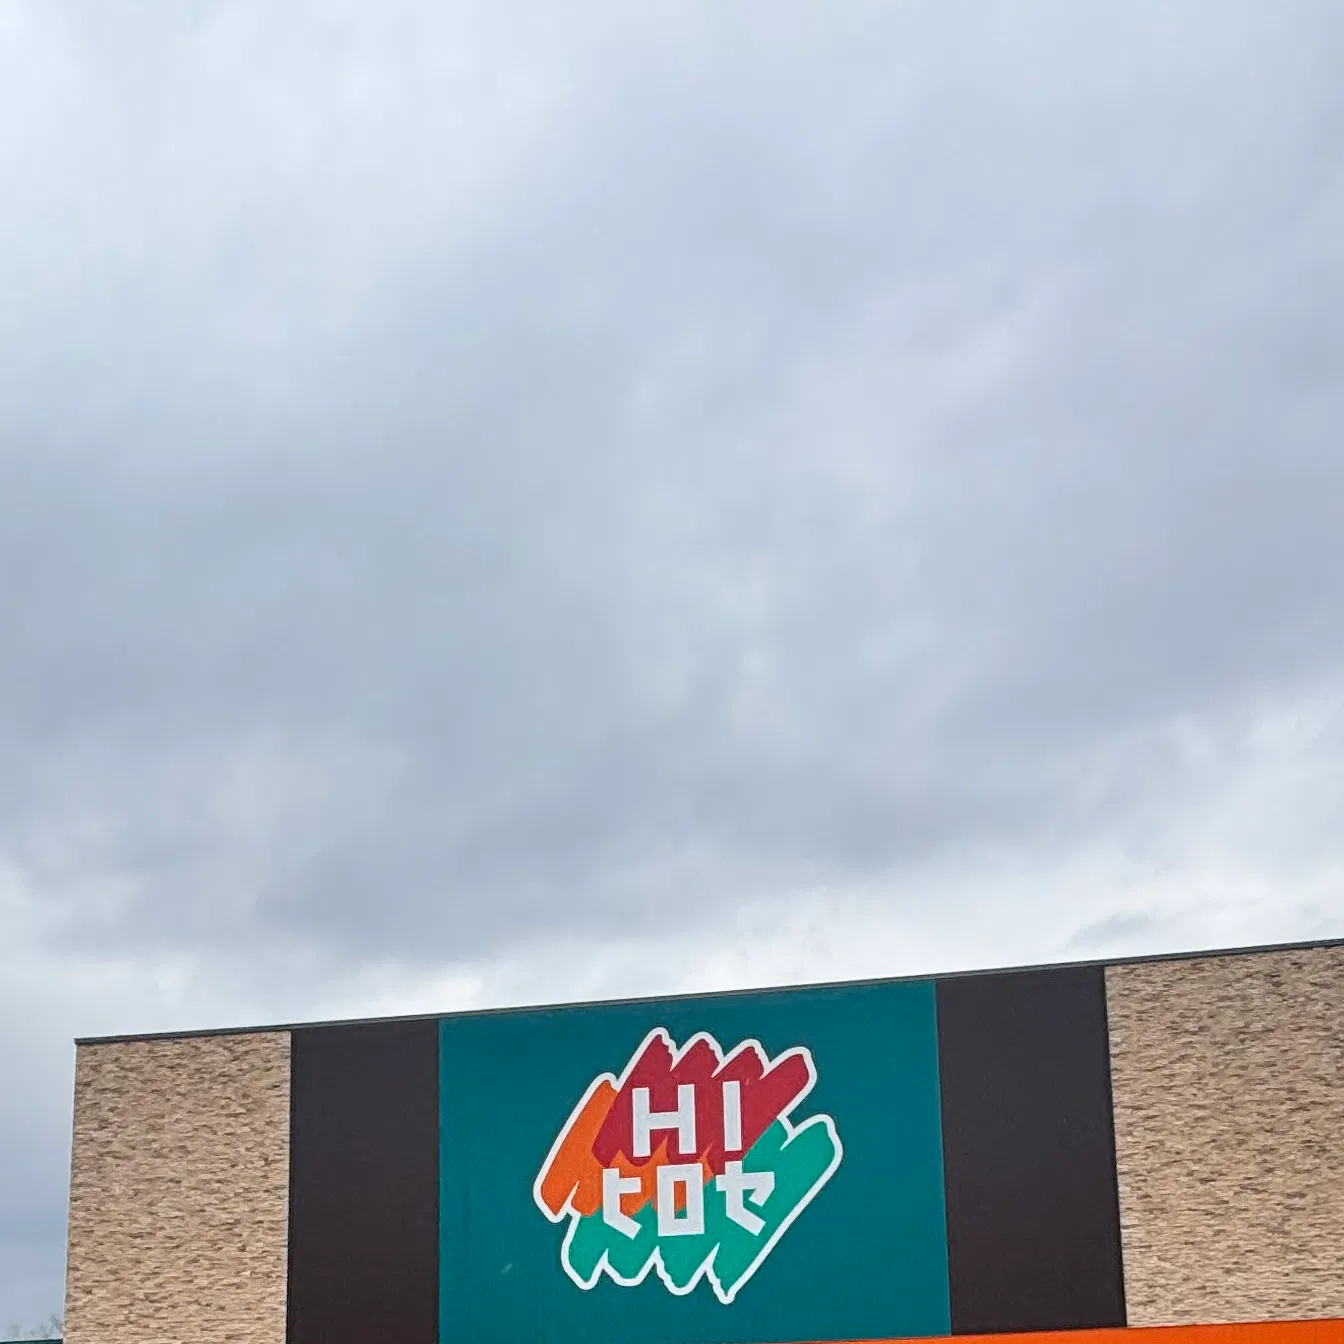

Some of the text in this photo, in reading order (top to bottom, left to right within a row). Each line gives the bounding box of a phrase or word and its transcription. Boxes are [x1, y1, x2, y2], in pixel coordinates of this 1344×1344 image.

[632, 1080, 742, 1158] HI
[602, 1160, 775, 1240] ヒロセ
